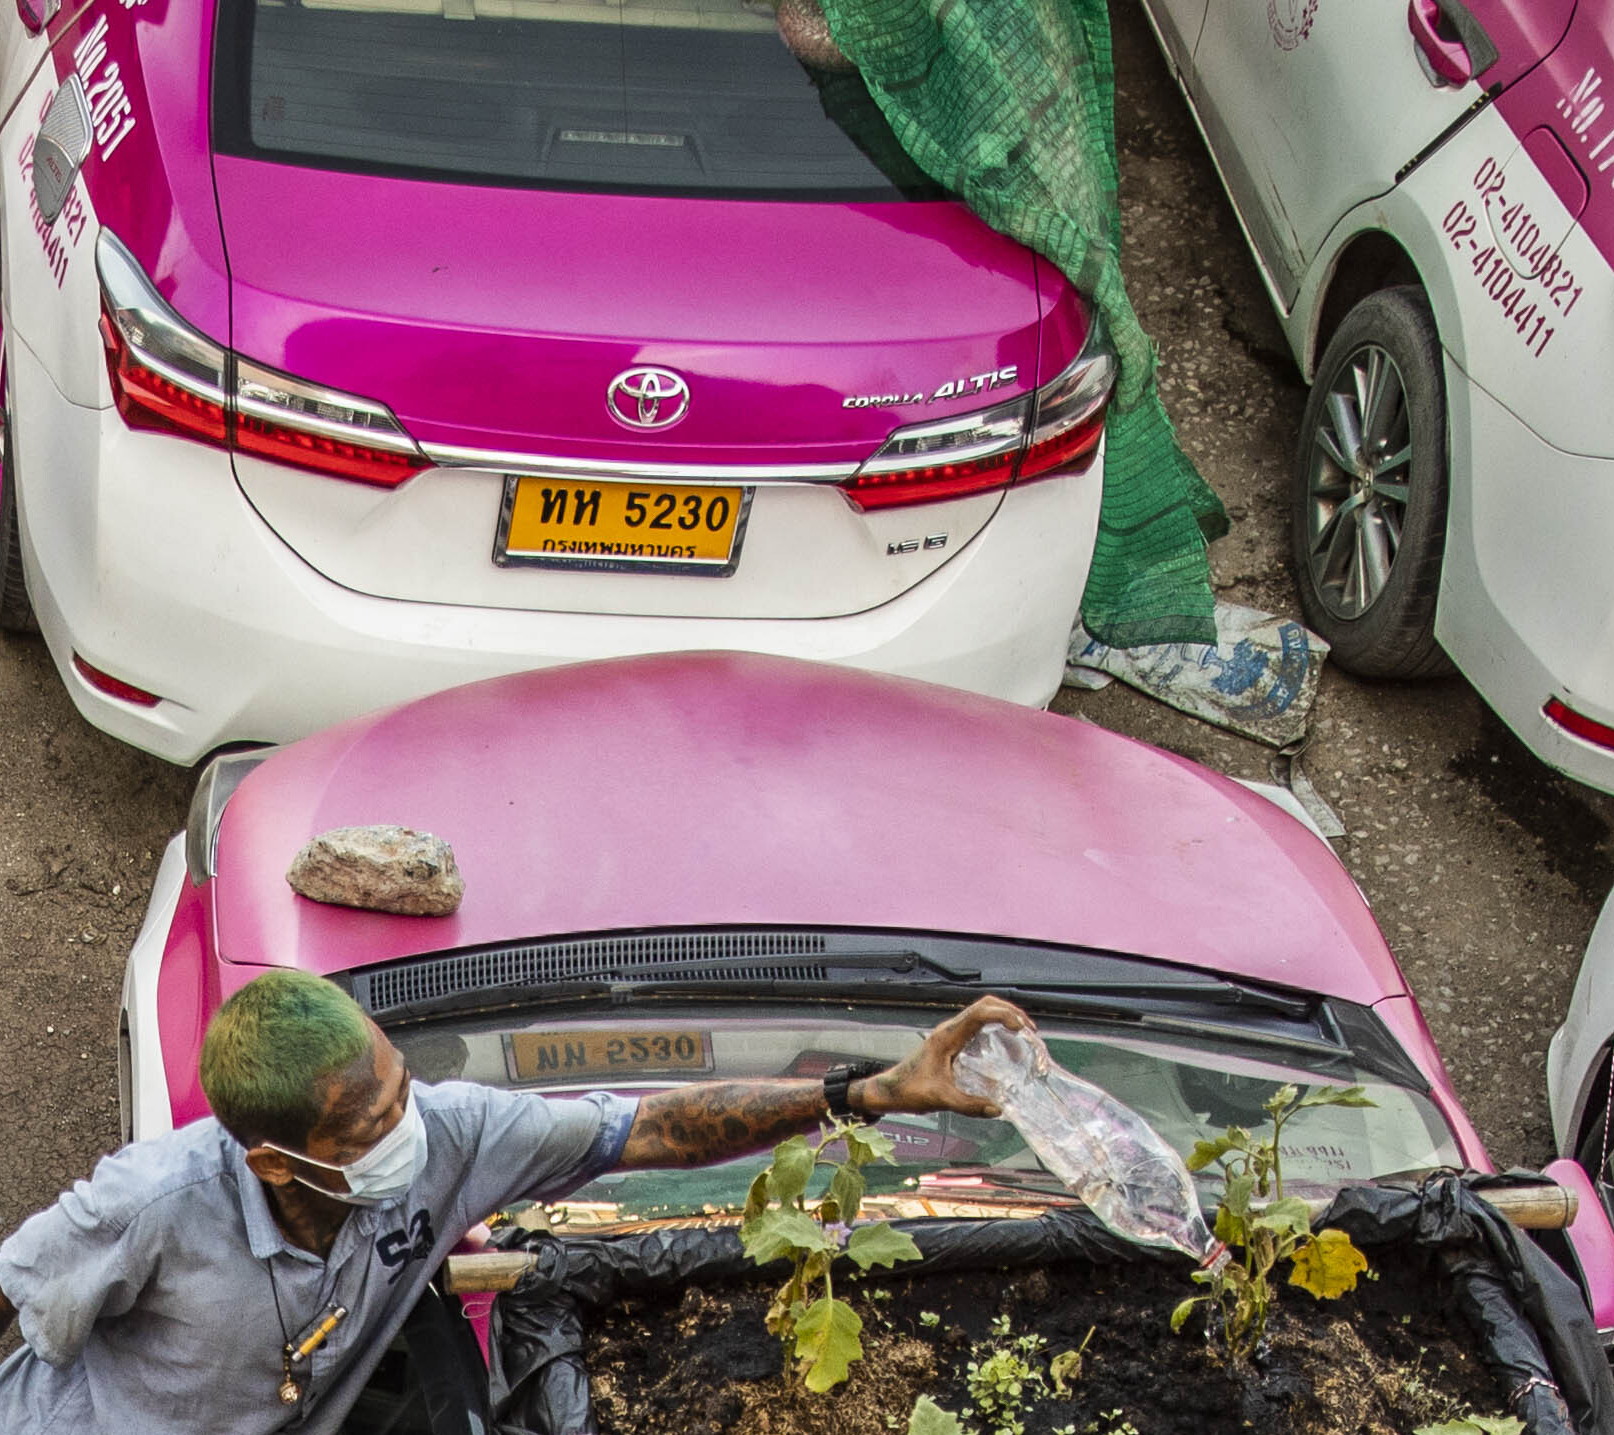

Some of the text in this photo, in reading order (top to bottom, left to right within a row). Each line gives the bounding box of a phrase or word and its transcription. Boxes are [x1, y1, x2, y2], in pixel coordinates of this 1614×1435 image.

[86, 61, 136, 163] 2051
[1556, 67, 1605, 143] No.
[1442, 200, 1554, 359] 02-4104411
[1473, 156, 1583, 317] 02-4104821
[842, 365, 1018, 409] COROLLA ALTIS
[541, 488, 730, 532] ทห 5230
